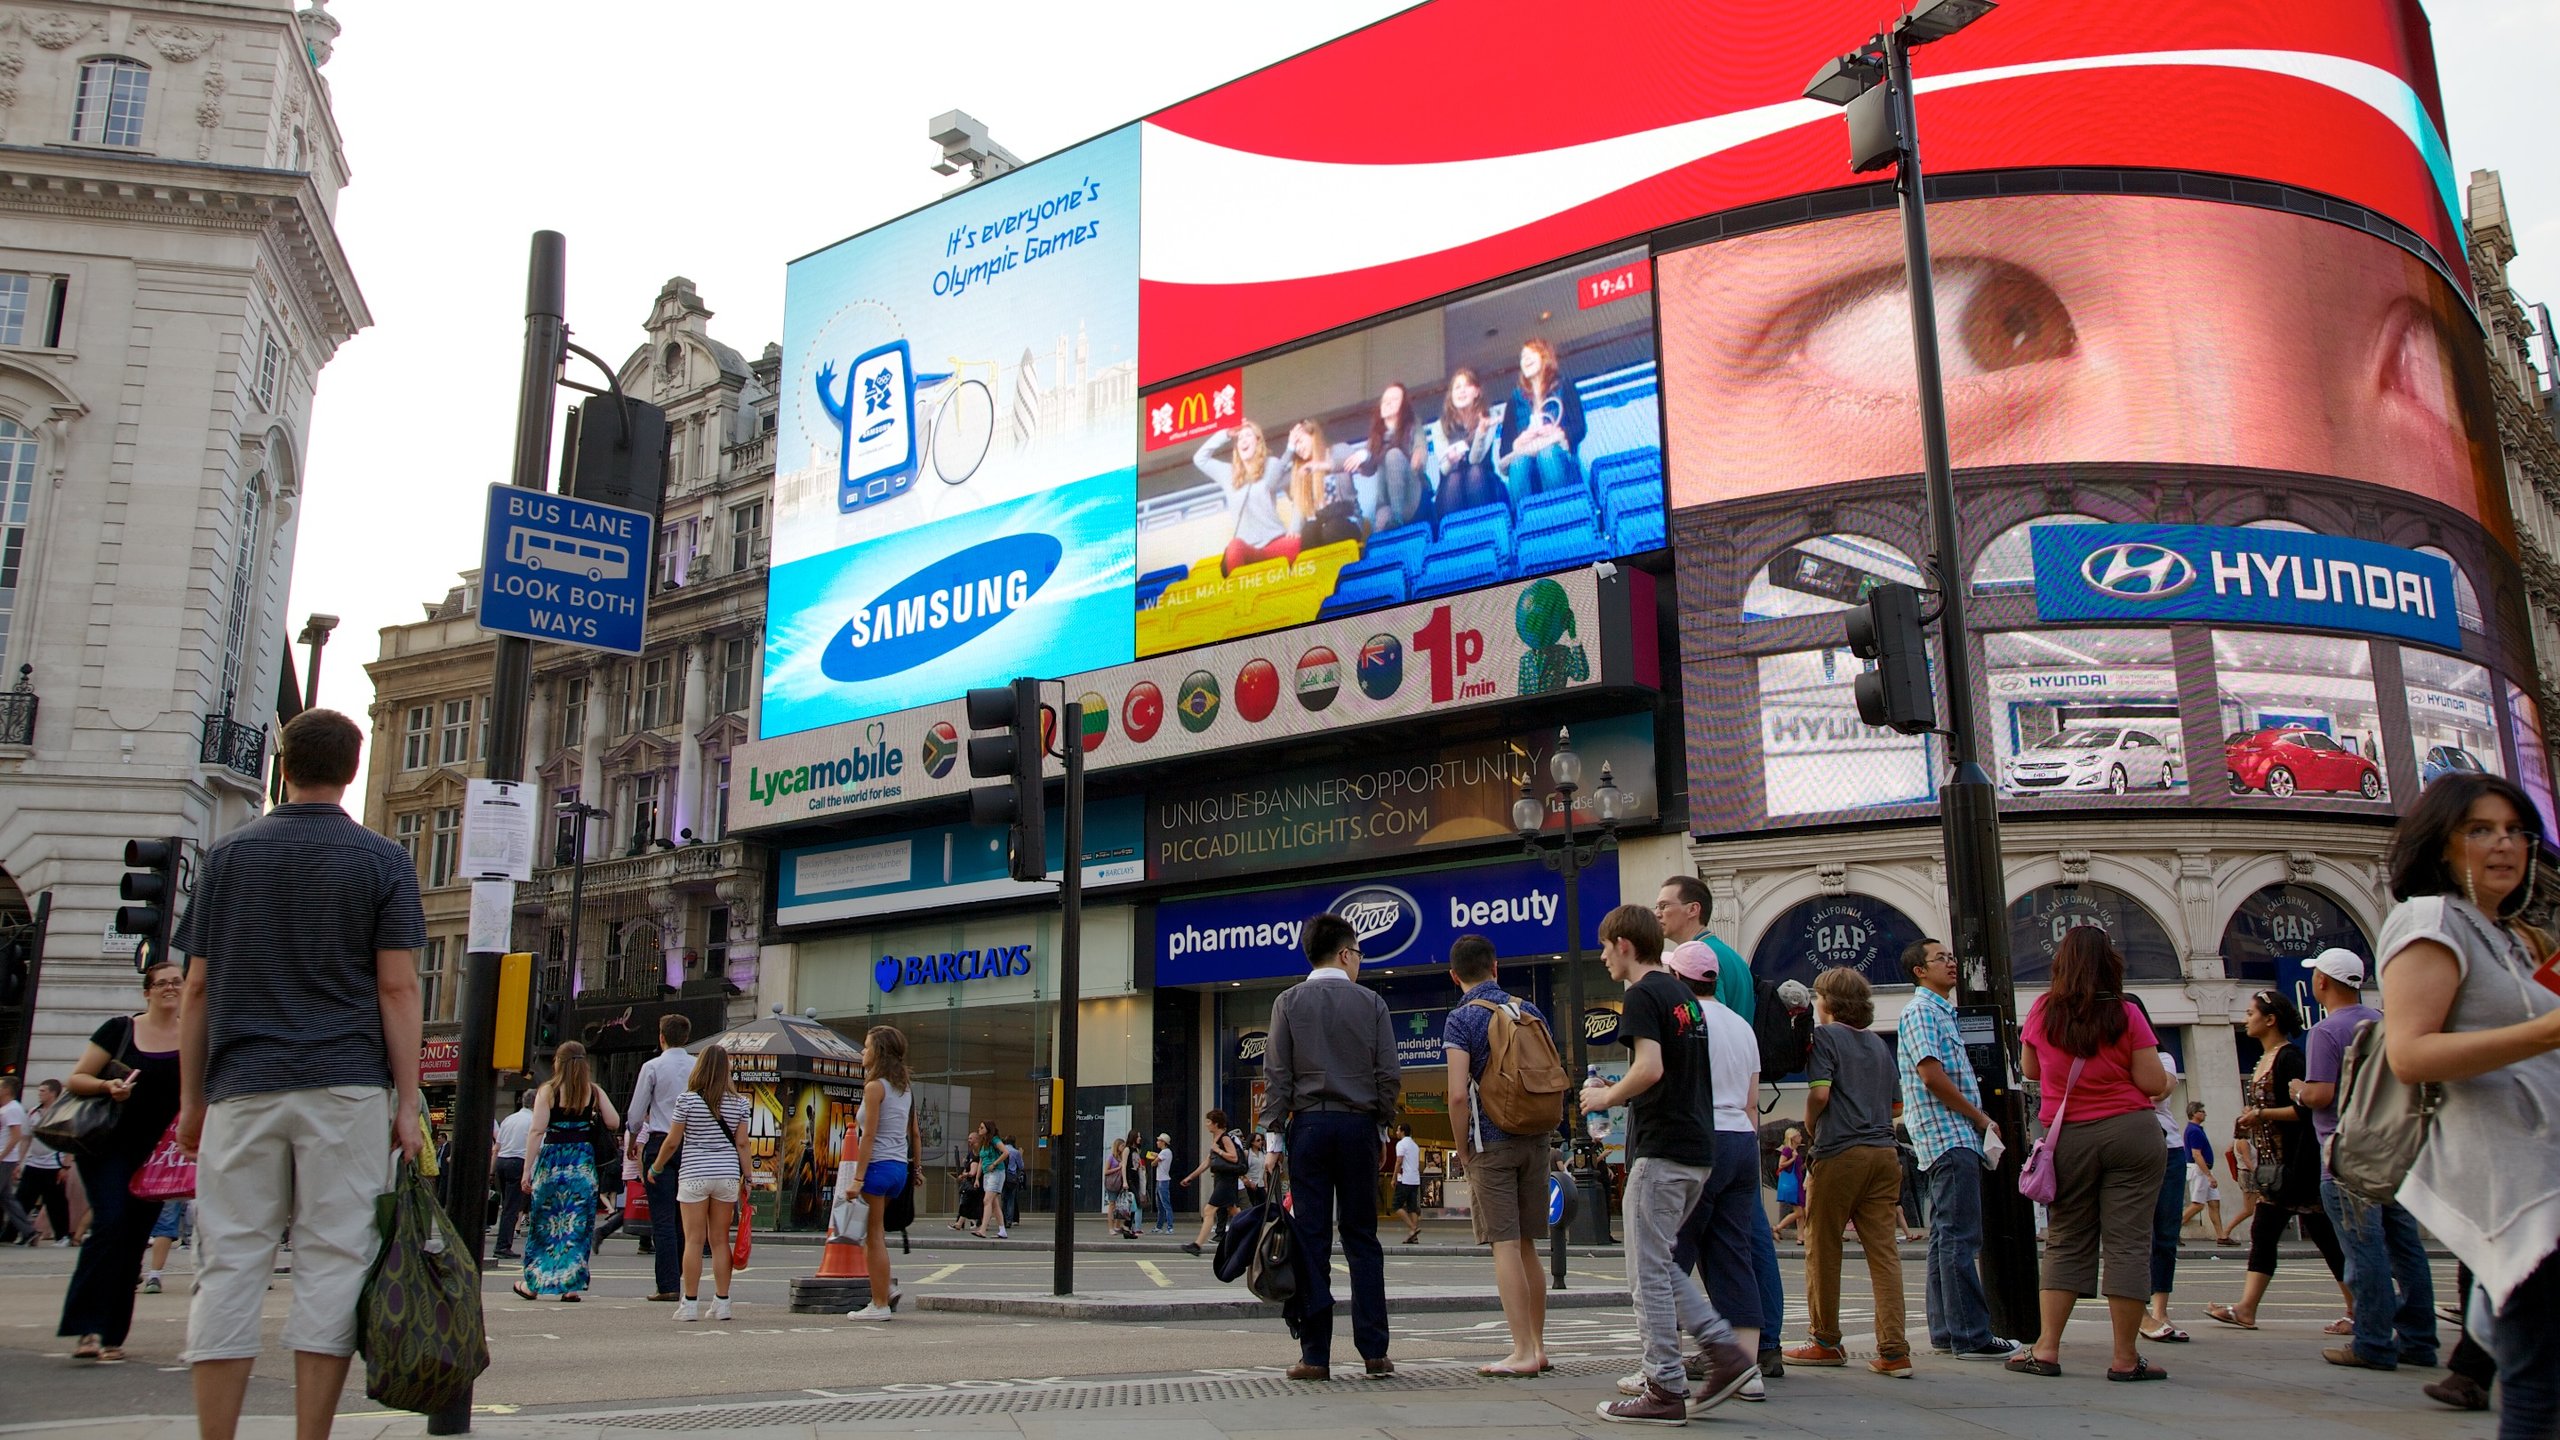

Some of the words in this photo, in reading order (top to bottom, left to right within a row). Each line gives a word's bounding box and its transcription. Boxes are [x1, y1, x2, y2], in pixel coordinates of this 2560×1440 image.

[946, 225, 976, 258] It's
[982, 176, 1100, 242] everyone's
[933, 244, 1018, 297] Olympic
[1024, 220, 1099, 264] Games
[1591, 272, 1634, 298] 19:41
[509, 496, 560, 524] BUS
[570, 509, 632, 538] LANE
[494, 574, 560, 602] LOOK
[570, 588, 634, 616] BOTH
[1144, 597, 1164, 610] WE
[1168, 591, 1192, 607] ALL
[1196, 581, 1235, 599] MAKE
[1238, 574, 1263, 590] THE
[1266, 562, 1316, 583] GAMES
[2210, 550, 2436, 618] HYUNDAI
[851, 570, 1028, 648] SAMSUNG
[530, 608, 598, 638] WAYS
[1414, 605, 1484, 704] 1p
[1460, 678, 1496, 699] /min
[2030, 674, 2106, 687] HYUNDAI
[2427, 694, 2467, 712] HYUNDAI
[750, 742, 903, 806] Lycamobile
[809, 798, 825, 810] Call
[827, 796, 842, 808] the
[843, 789, 868, 804] world
[869, 789, 882, 800] for
[883, 786, 901, 796] less
[1161, 794, 1250, 830] UNIQUE
[1254, 778, 1349, 815] BANNER
[1355, 748, 1543, 802] OPPORTUNITY
[1162, 806, 1428, 865] PICCADILLYLIGHTS.COM
[1106, 866, 1134, 877] BARCLAYS
[1340, 900, 1400, 942] Boots
[1451, 889, 1559, 928] beauty
[2100, 910, 2114, 927] USA
[2311, 911, 2323, 929] USA
[1169, 920, 1302, 961] pharmacy
[1804, 922, 1816, 939] S.F.
[1863, 918, 1877, 936] USA
[1817, 925, 1866, 953] GAP
[2272, 915, 2314, 943] GAP
[1828, 950, 1856, 960] 1969
[2282, 941, 2308, 951] 1969
[904, 944, 1032, 986] BARCLAYS
[1585, 1014, 1618, 1038] Boots
[420, 1045, 459, 1060] ONUTS
[1239, 1038, 1267, 1058] Boot
[1397, 1037, 1441, 1050] midnight
[1397, 1049, 1441, 1061] pharmacy
[421, 1060, 451, 1068] BAGUETTES
[757, 1055, 777, 1071] YOU
[733, 1072, 739, 1081] &
[802, 1376, 1095, 1398] LOOK
